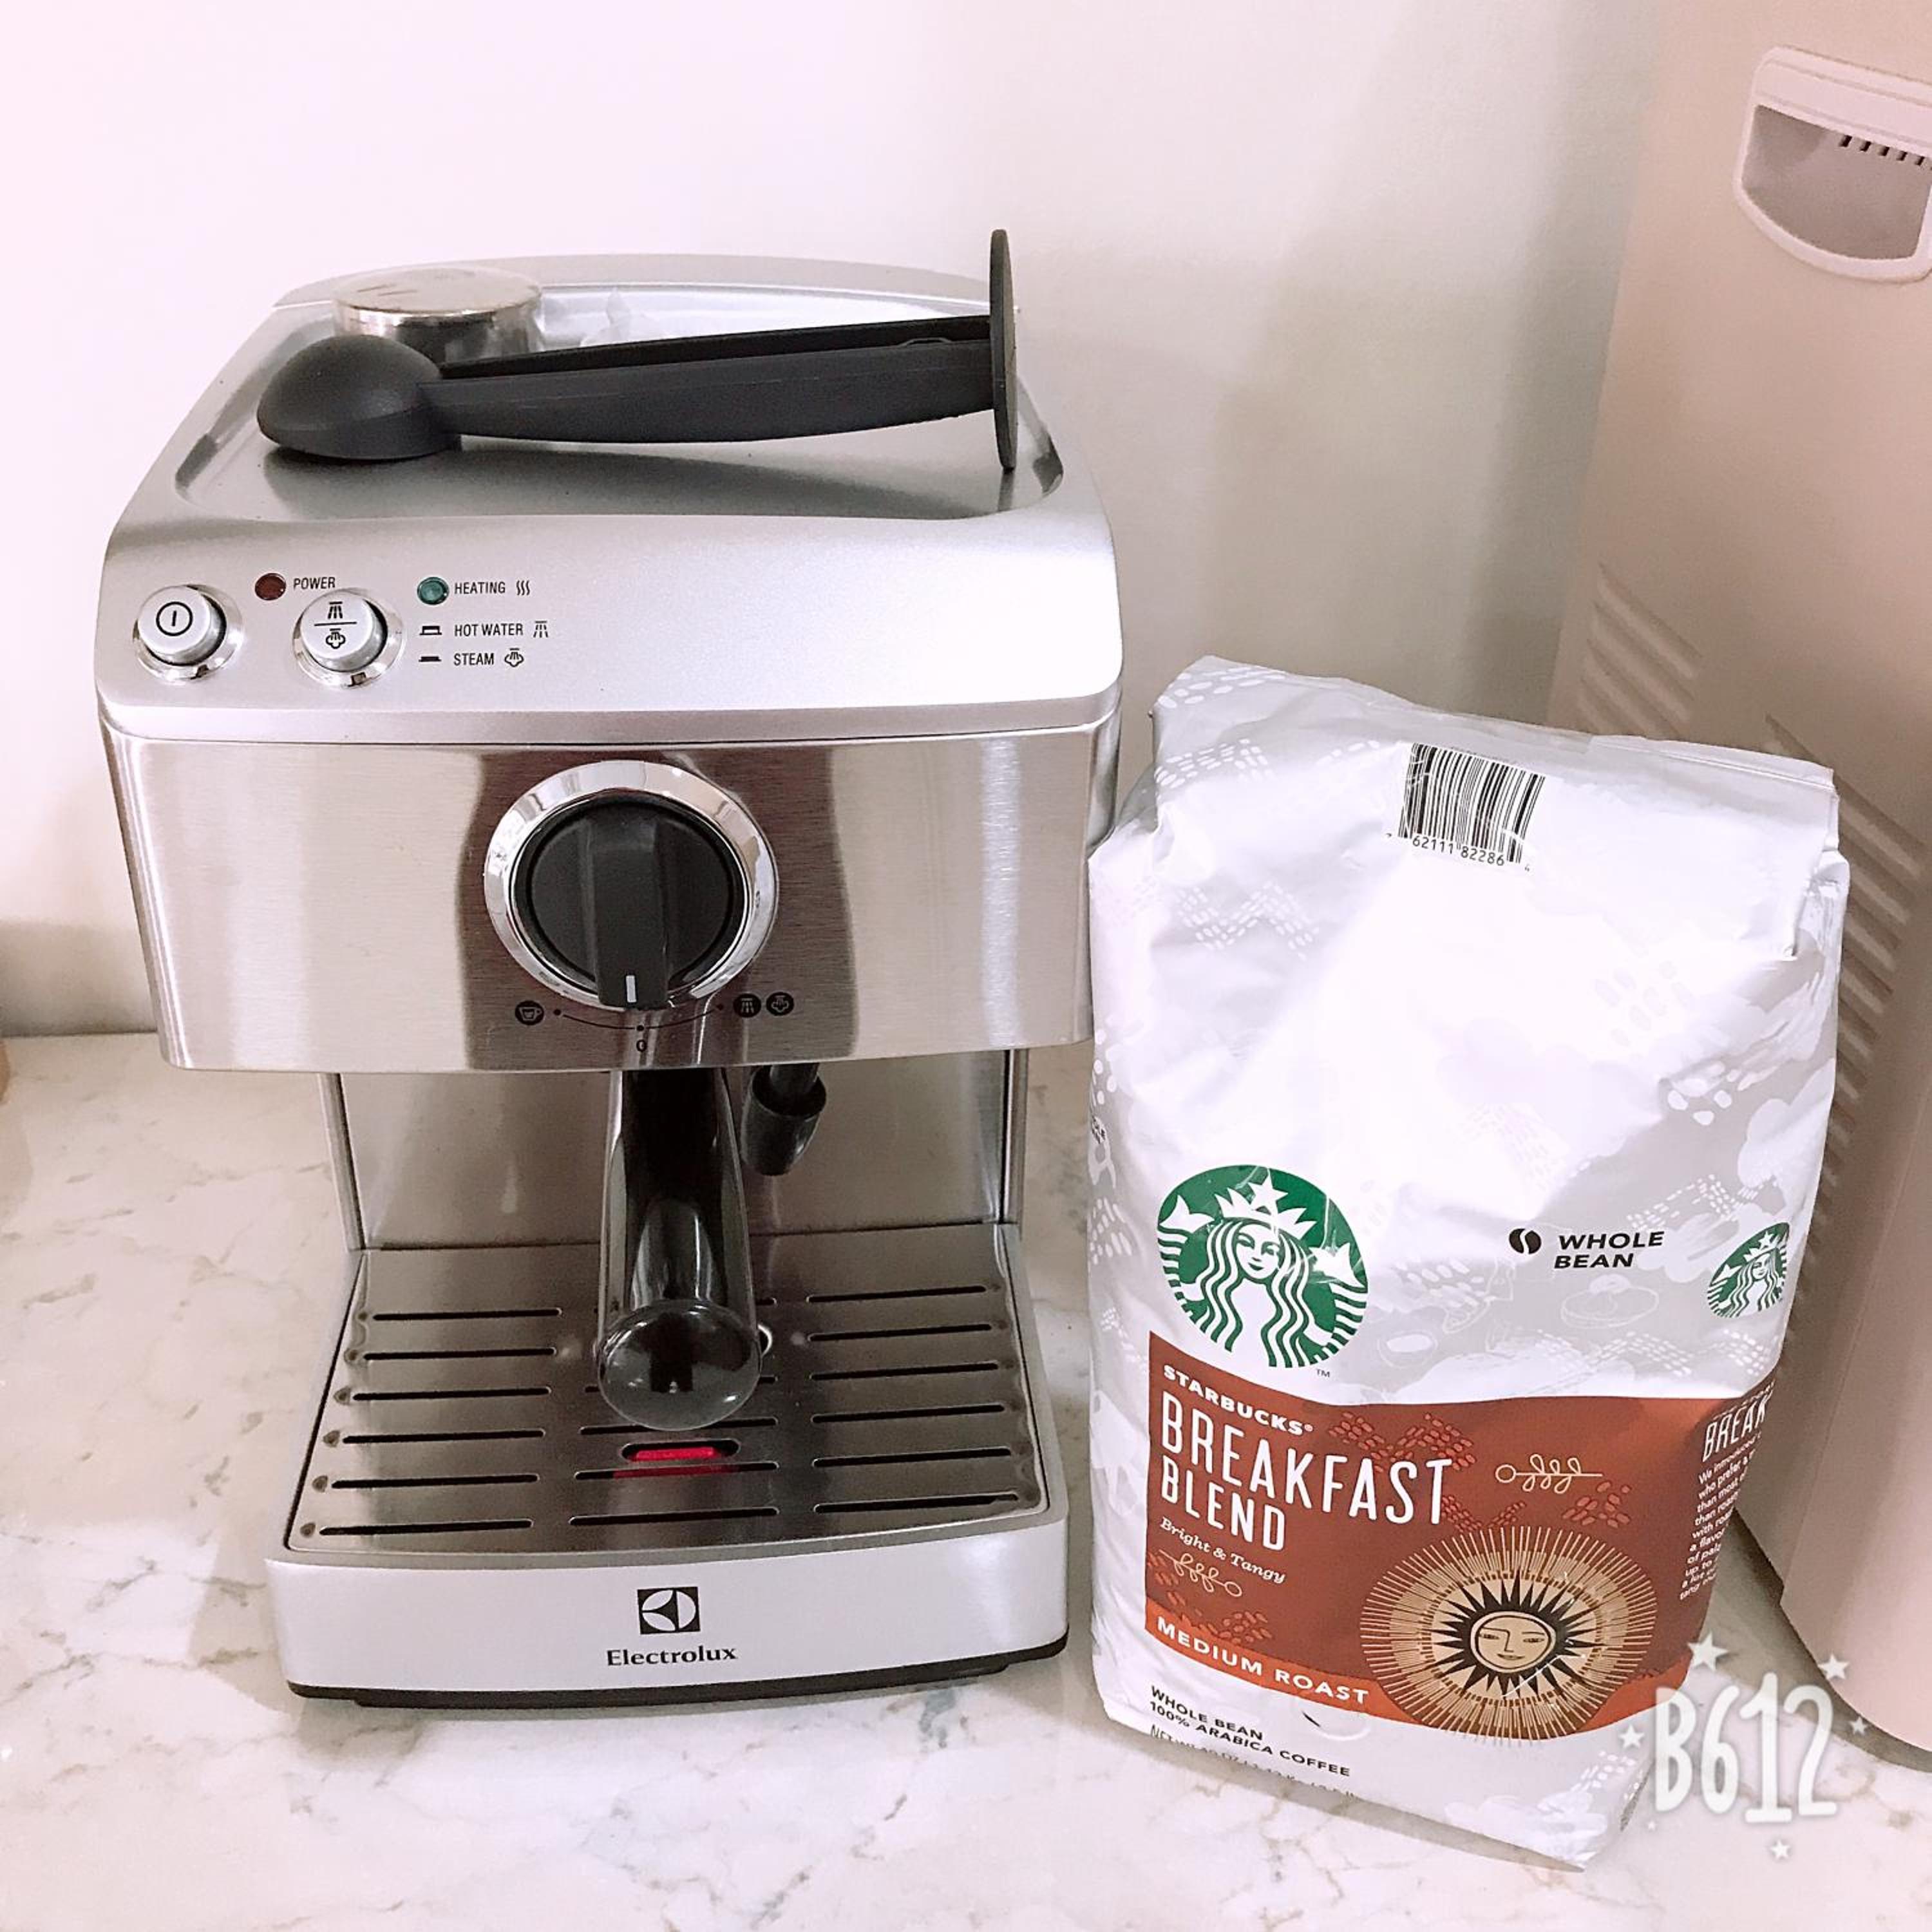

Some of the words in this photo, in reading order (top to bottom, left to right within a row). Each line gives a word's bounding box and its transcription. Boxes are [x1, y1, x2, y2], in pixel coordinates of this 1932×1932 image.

[293, 577, 336, 589] POWER
[454, 581, 506, 594] HEATING
[454, 623, 478, 636] HOT
[481, 623, 523, 636] WATER
[453, 652, 494, 666] STEAM
[1461, 846, 1504, 866] 82286
[1558, 1231, 1665, 1249] WHOLE
[1554, 1253, 1634, 1269] BEAN
[1161, 1390, 1453, 1525] BREAKFAST
[1161, 1455, 1285, 1551] BLEND
[1160, 1517, 1211, 1553] Bright
[1213, 1547, 1226, 1560] &
[1230, 1553, 1285, 1584] Tangy
[607, 1645, 737, 1666] Electrolux
[1157, 1616, 1262, 1675] MEDIUM
[1274, 1669, 1369, 1705] ROAST
[1151, 1685, 1208, 1723] WHOLE
[1215, 1718, 1264, 1741] BEAN
[1150, 1701, 1191, 1728] 100%
[1195, 1724, 1273, 1755] ARABICA
[1279, 1749, 1351, 1777] COFFEE
